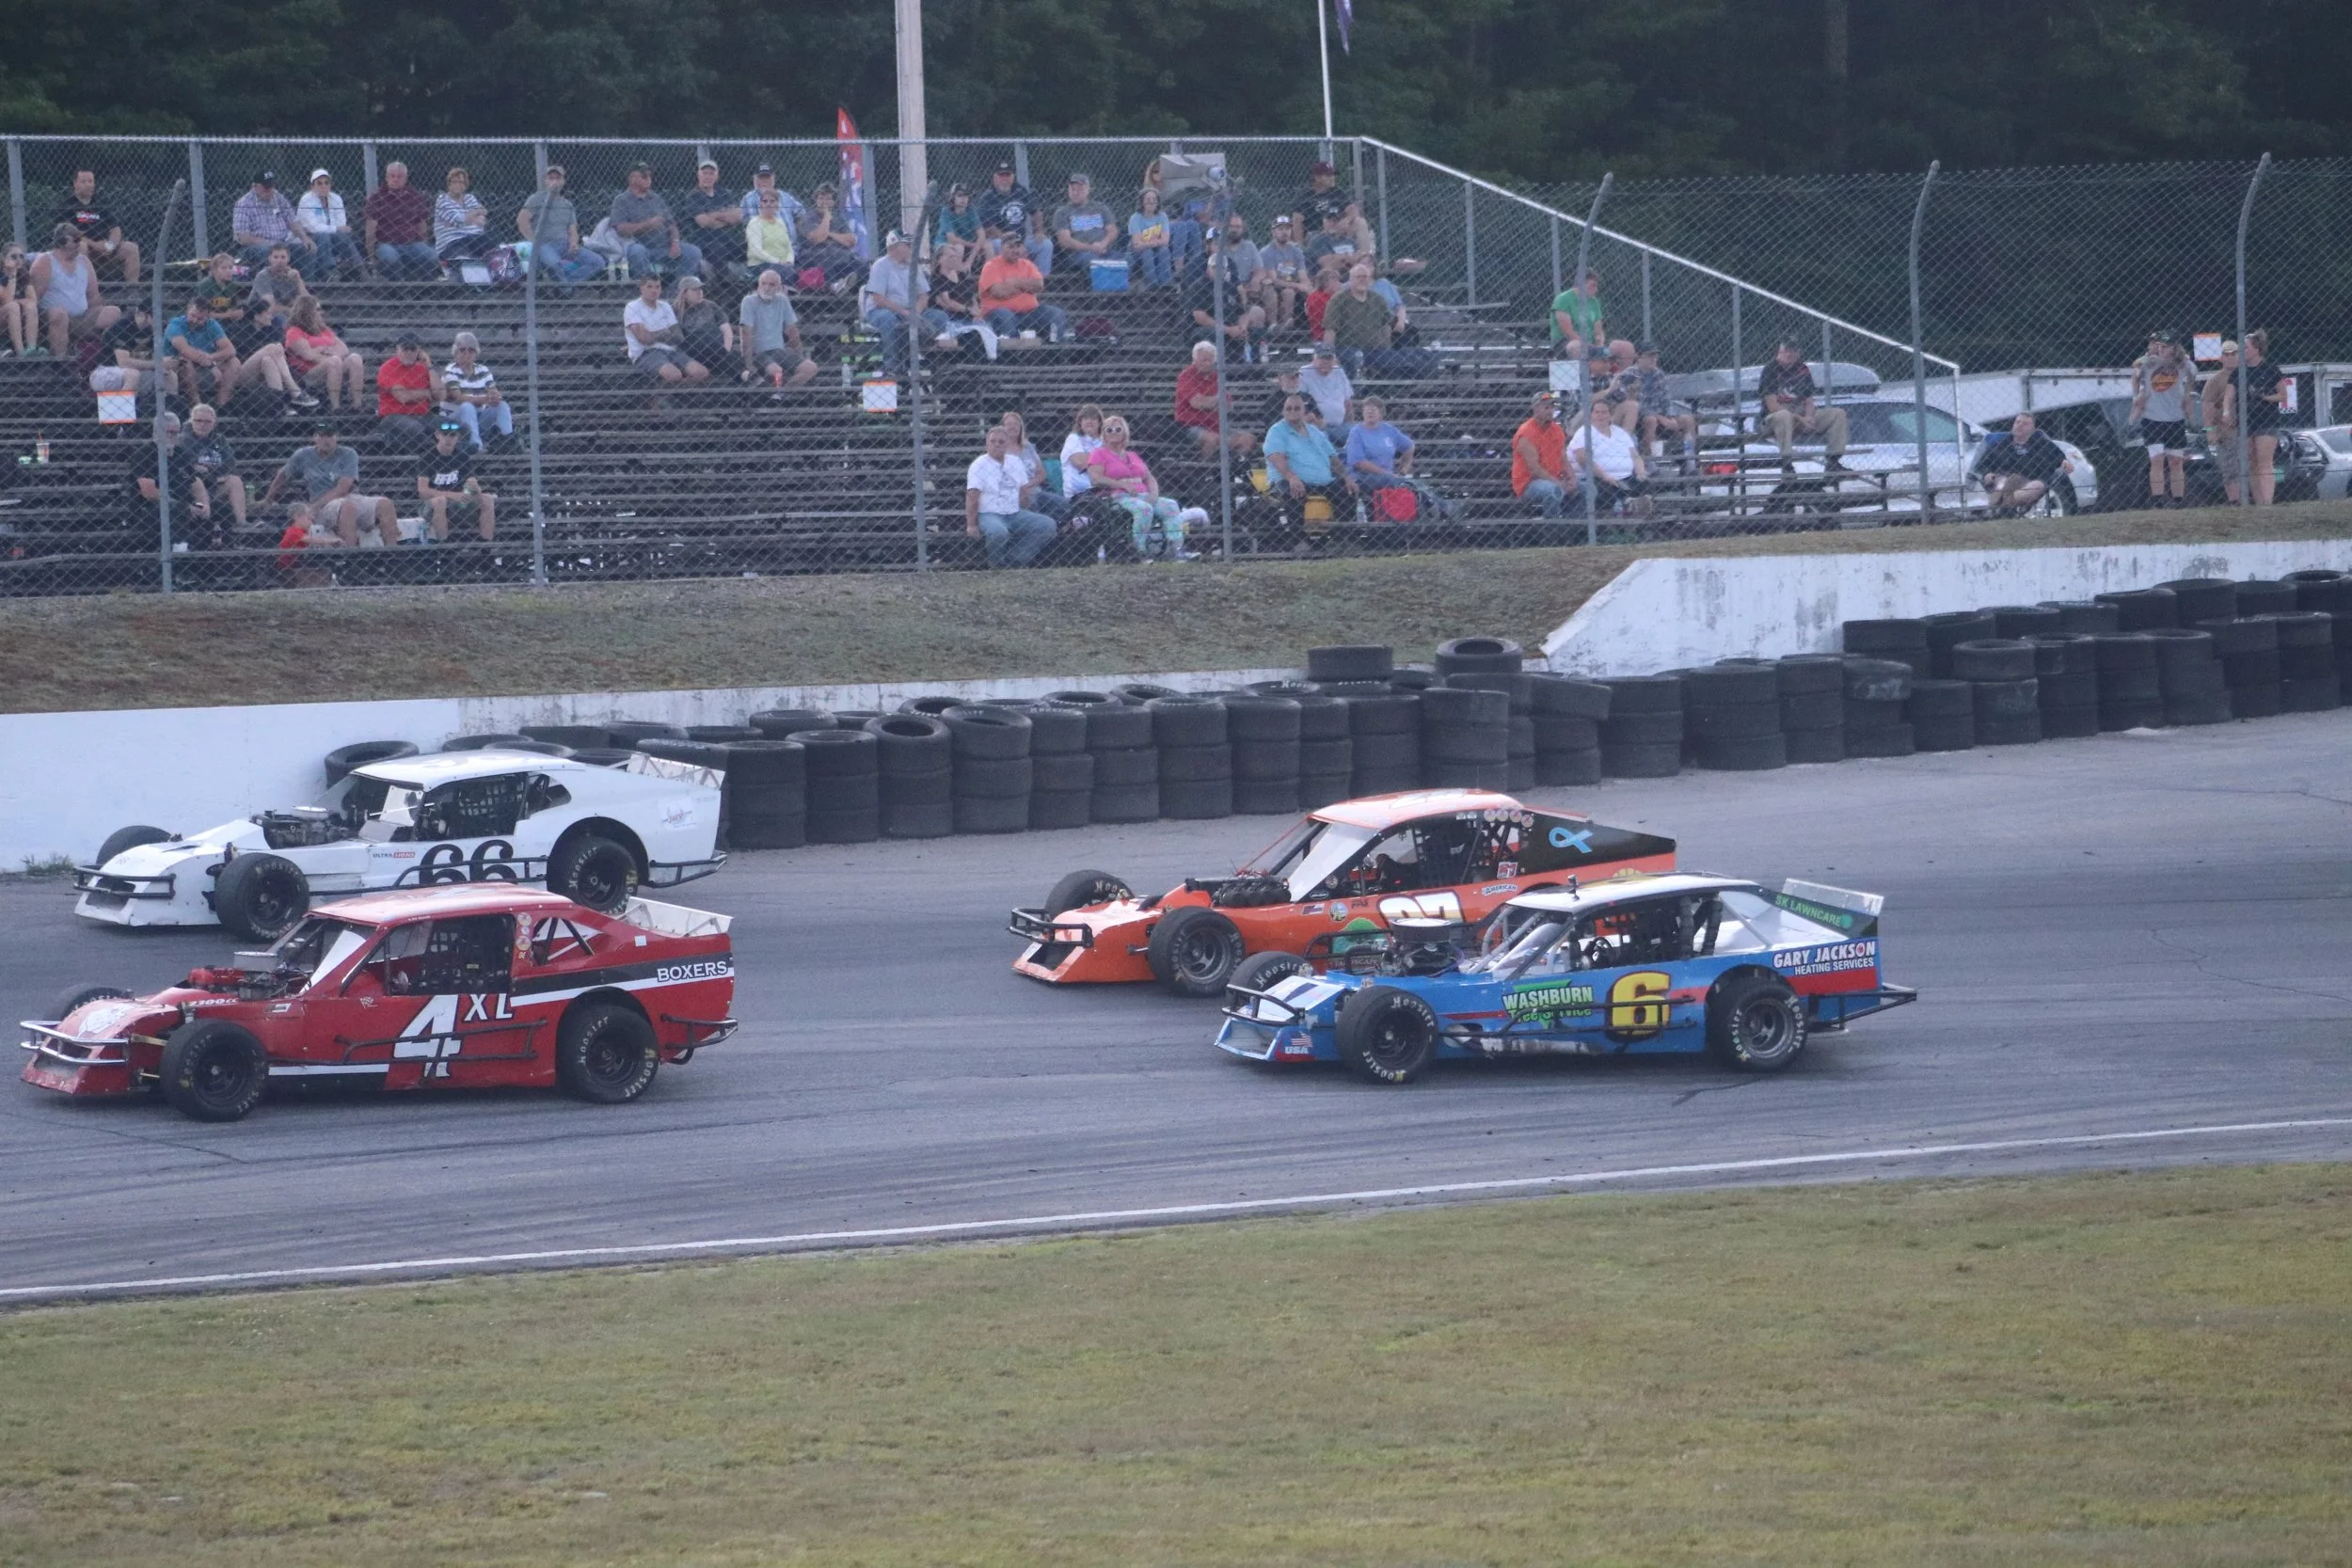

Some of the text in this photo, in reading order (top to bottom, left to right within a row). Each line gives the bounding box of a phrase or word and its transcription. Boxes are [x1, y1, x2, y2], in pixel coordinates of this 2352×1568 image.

[418, 839, 518, 885] 66
[1789, 900, 1841, 927] LAWNCARE
[1773, 941, 1876, 969] GARY JACKSON
[1794, 958, 1874, 975] HEATING SERVICES
[657, 960, 728, 982] BOXERS
[1502, 986, 1593, 1010] WASHBURN
[1605, 971, 1672, 1042] 6
[393, 992, 514, 1078] 4 XL
[1285, 1046, 1309, 1054] USA
